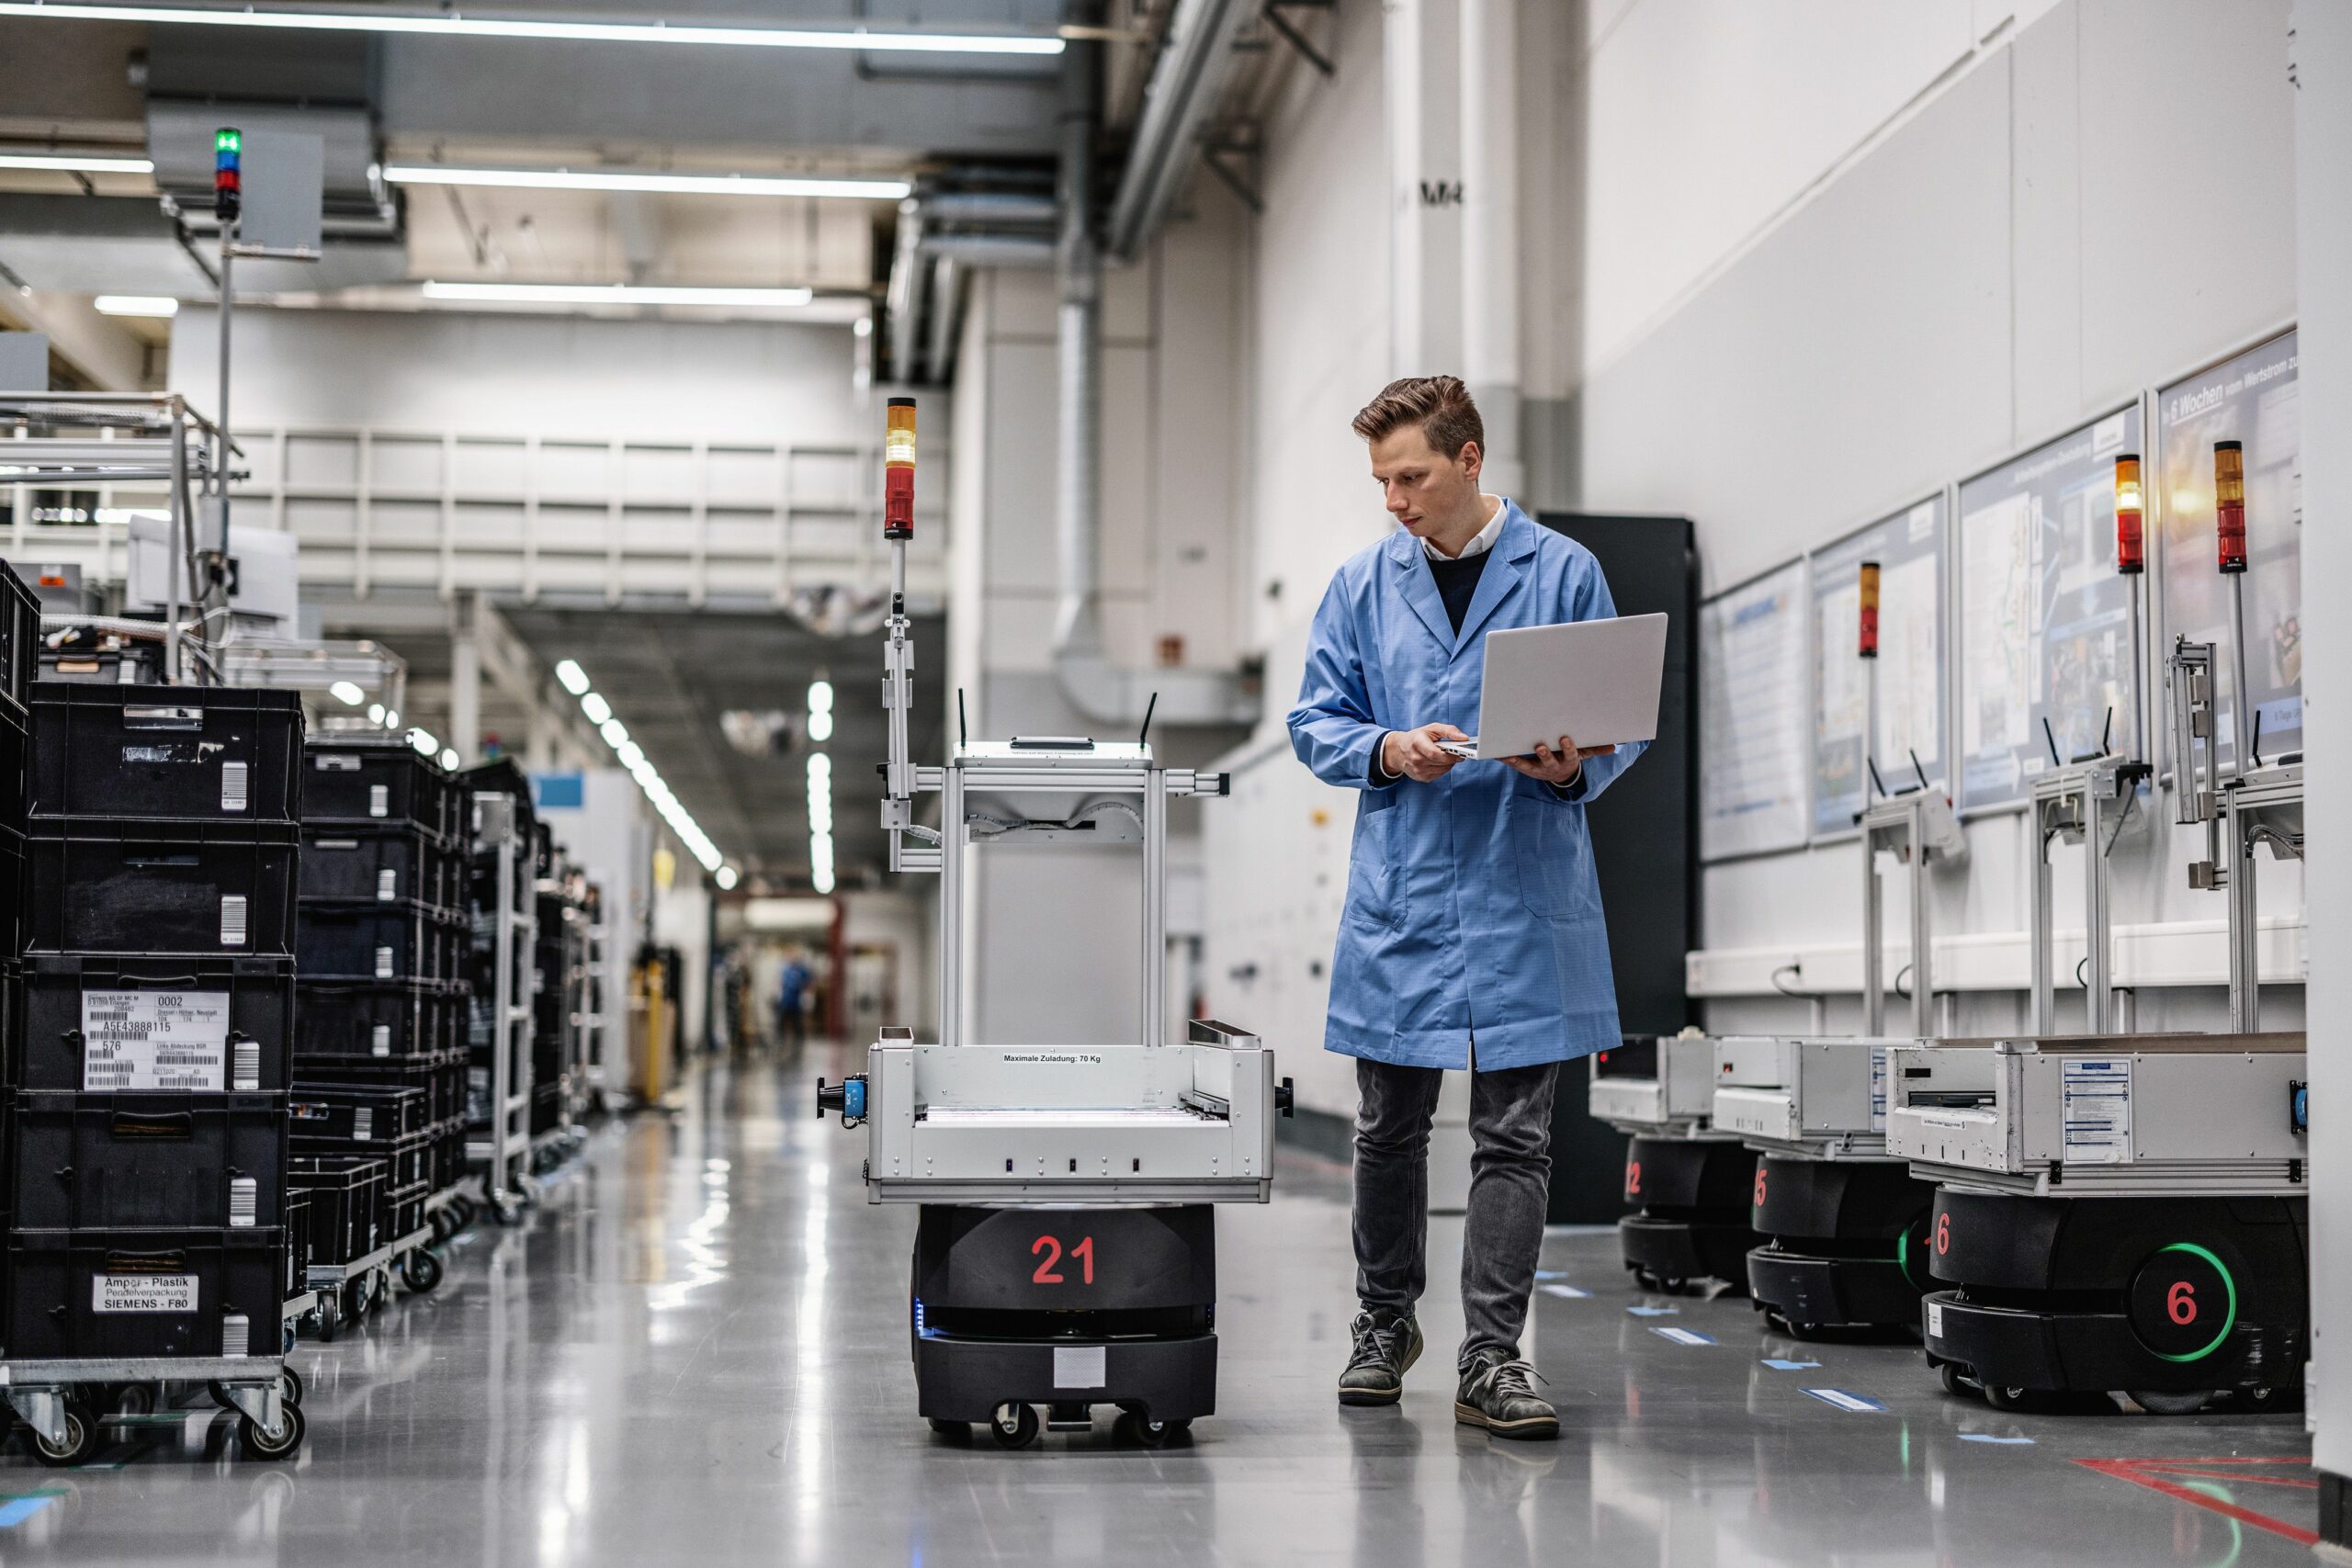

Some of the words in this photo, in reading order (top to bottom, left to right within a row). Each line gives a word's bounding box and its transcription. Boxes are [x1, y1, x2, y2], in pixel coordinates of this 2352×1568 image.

[2171, 399, 2178, 421] 6
[2180, 383, 2224, 417] Wochen
[2244, 359, 2288, 388] Wertstrom
[158, 997, 183, 1007] 0002
[103, 1021, 171, 1032] A5E43888115
[102, 1041, 121, 1051] 576
[1040, 1055, 1078, 1064] Zuladung:
[1090, 1055, 1101, 1064] Kg
[1937, 1213, 1950, 1256] 6
[1031, 1235, 1093, 1285] 21
[152, 1278, 189, 1287] Plastik
[106, 1288, 187, 1298] Pendelverpackung
[104, 1299, 157, 1309] SIEMENS
[168, 1299, 188, 1308] F80
[2166, 1280, 2198, 1325] 6
